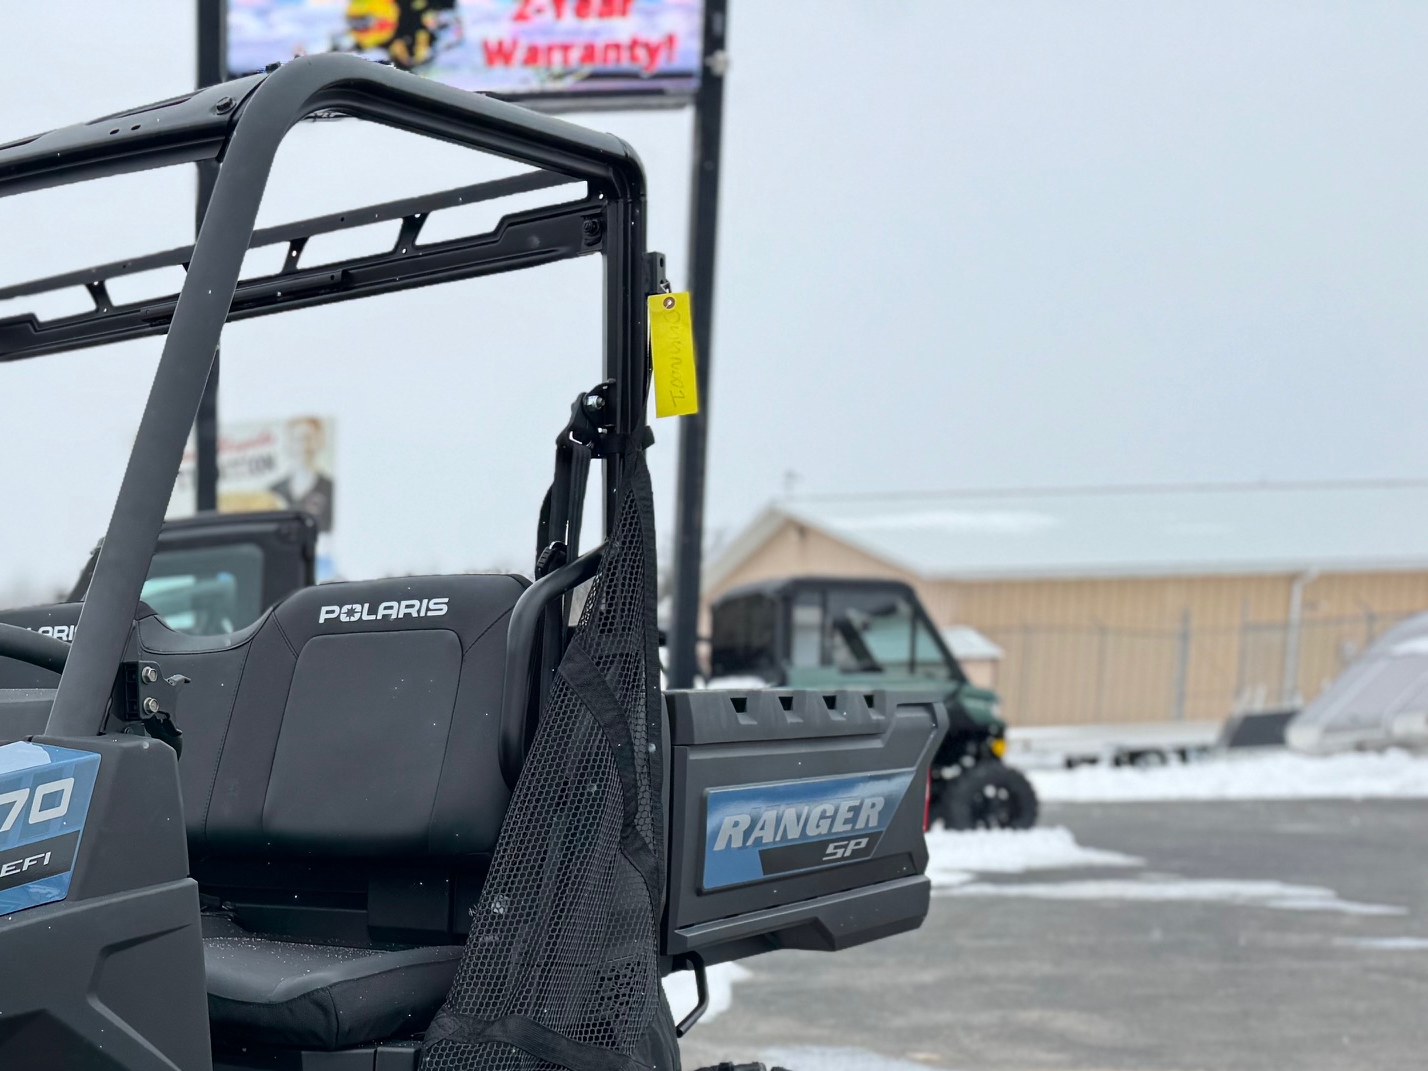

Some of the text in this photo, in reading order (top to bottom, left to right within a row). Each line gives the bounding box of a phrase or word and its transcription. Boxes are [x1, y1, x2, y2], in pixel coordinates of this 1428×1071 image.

[482, 32, 678, 74] Warranty!
[318, 597, 449, 624] POLARIS
[712, 796, 885, 852] RANGER
[822, 837, 869, 861] SP
[0, 851, 52, 878] EFI
